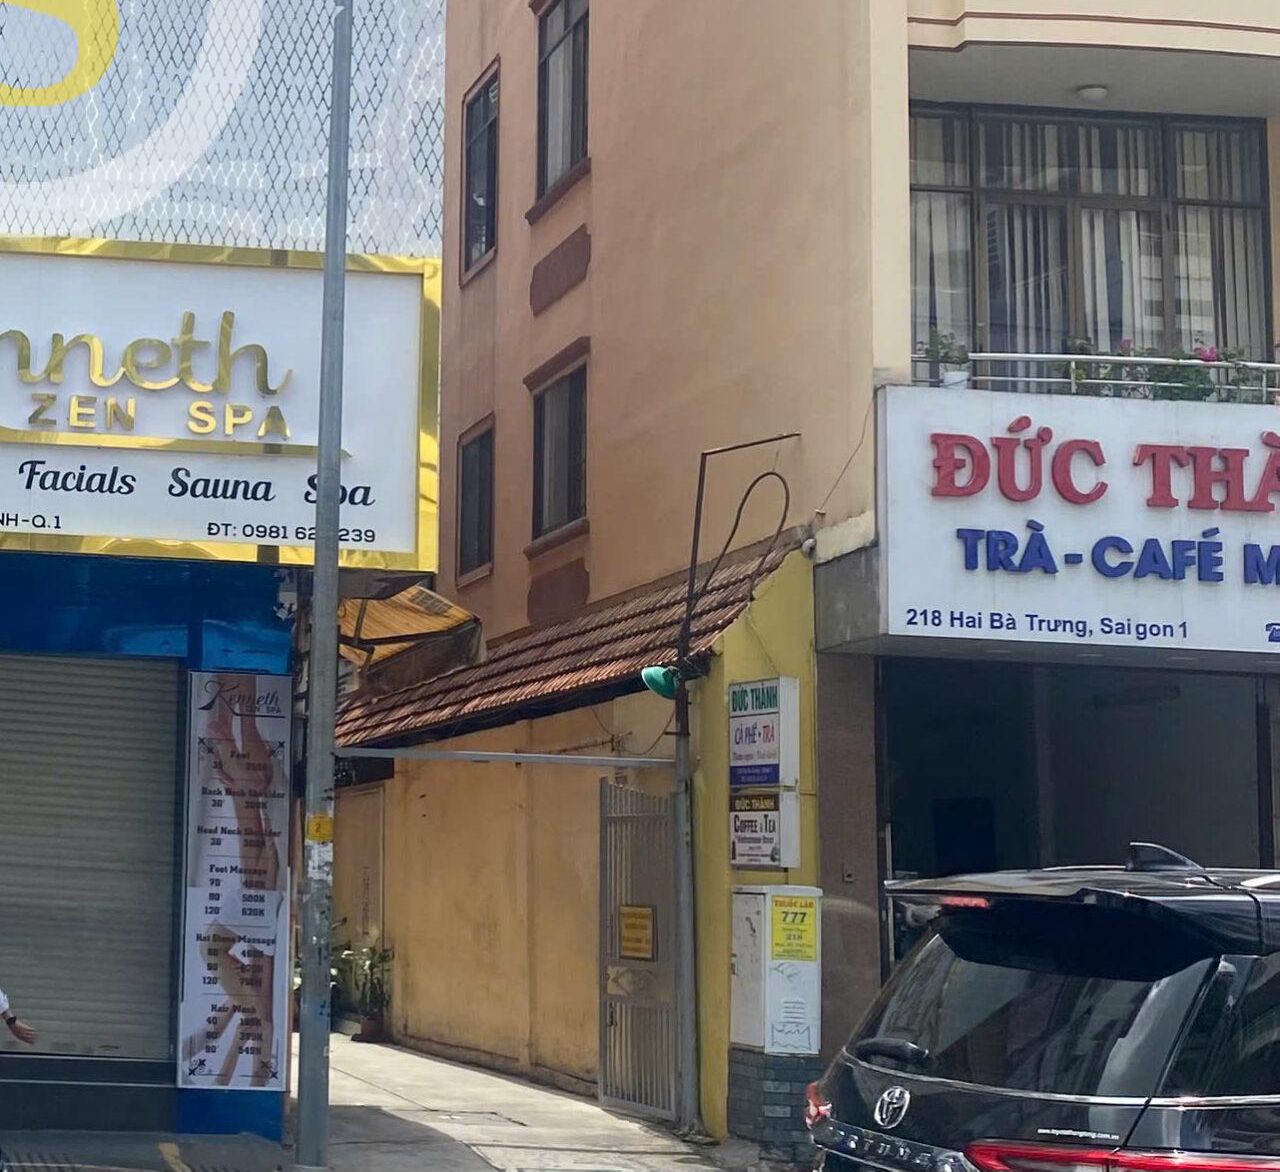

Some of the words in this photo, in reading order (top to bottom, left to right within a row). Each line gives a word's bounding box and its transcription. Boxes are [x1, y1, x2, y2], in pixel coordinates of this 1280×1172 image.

[28, 393, 137, 431] ZEN
[187, 400, 291, 441] SPA
[931, 415, 1109, 505] ĐỨC
[19, 459, 136, 496] Facials
[168, 467, 276, 502] Sauna
[207, 522, 236, 538] ĐT:
[242, 524, 288, 540] 0981
[906, 609, 942, 626] 218
[950, 611, 982, 629] Hai
[989, 612, 1016, 630] Bà
[1025, 614, 1093, 637] Trưng,
[751, 683, 778, 711] THÀNH
[781, 911, 807, 924] 777
